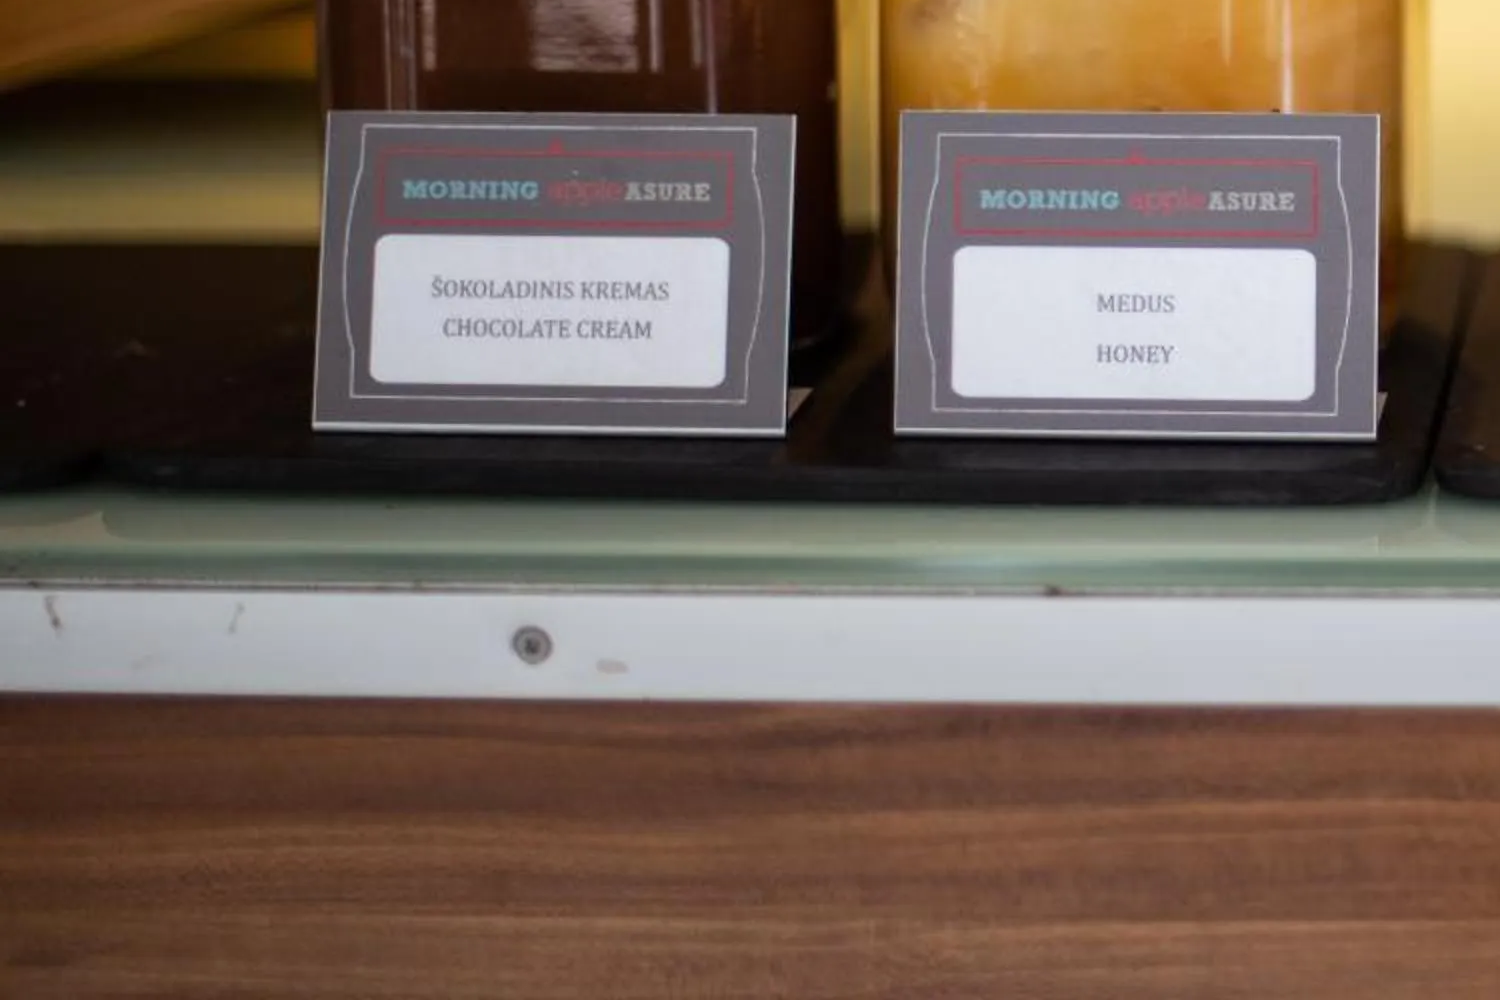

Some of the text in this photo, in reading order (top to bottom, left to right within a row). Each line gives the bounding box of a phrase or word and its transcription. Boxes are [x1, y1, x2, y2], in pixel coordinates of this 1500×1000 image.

[402, 179, 538, 200] MORNING
[980, 189, 1119, 210] MORNING
[431, 275, 669, 301] ŠOKOLADINIS KREMAS
[1097, 293, 1175, 313] MEDUS
[443, 319, 652, 339] CHOCOLATE CREAM
[1097, 345, 1175, 364] HONEY
